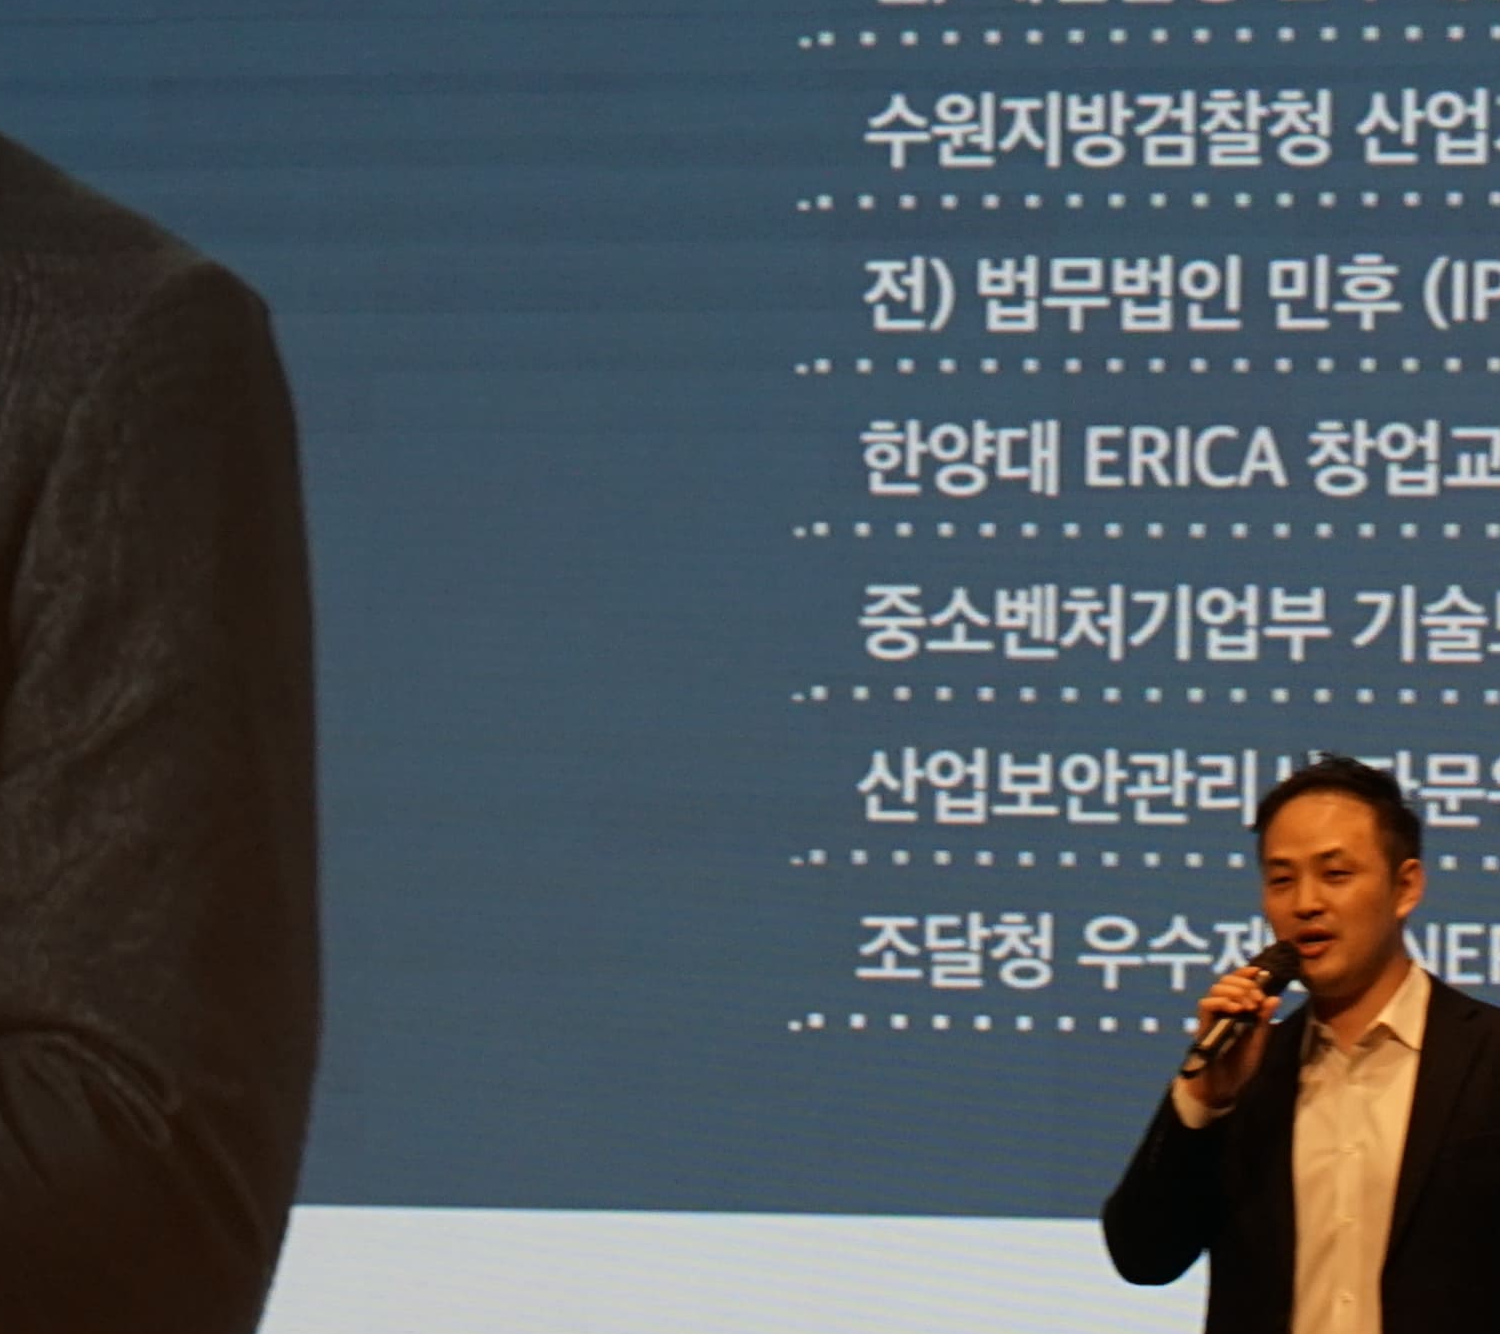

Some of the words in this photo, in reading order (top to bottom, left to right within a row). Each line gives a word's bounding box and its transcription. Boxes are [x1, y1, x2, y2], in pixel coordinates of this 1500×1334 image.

[863, 87, 1332, 170] 수원지방검찰청
[863, 254, 955, 332] 전)
[976, 253, 1242, 333] 법무법인
[1268, 253, 1403, 332] 민후
[859, 418, 1060, 497] 한양대
[1084, 424, 1288, 489] ERICA
[858, 582, 1333, 663] 중소벤처기업부
[856, 745, 1322, 827] 산업보안관리
[854, 910, 1054, 990] 조달청
